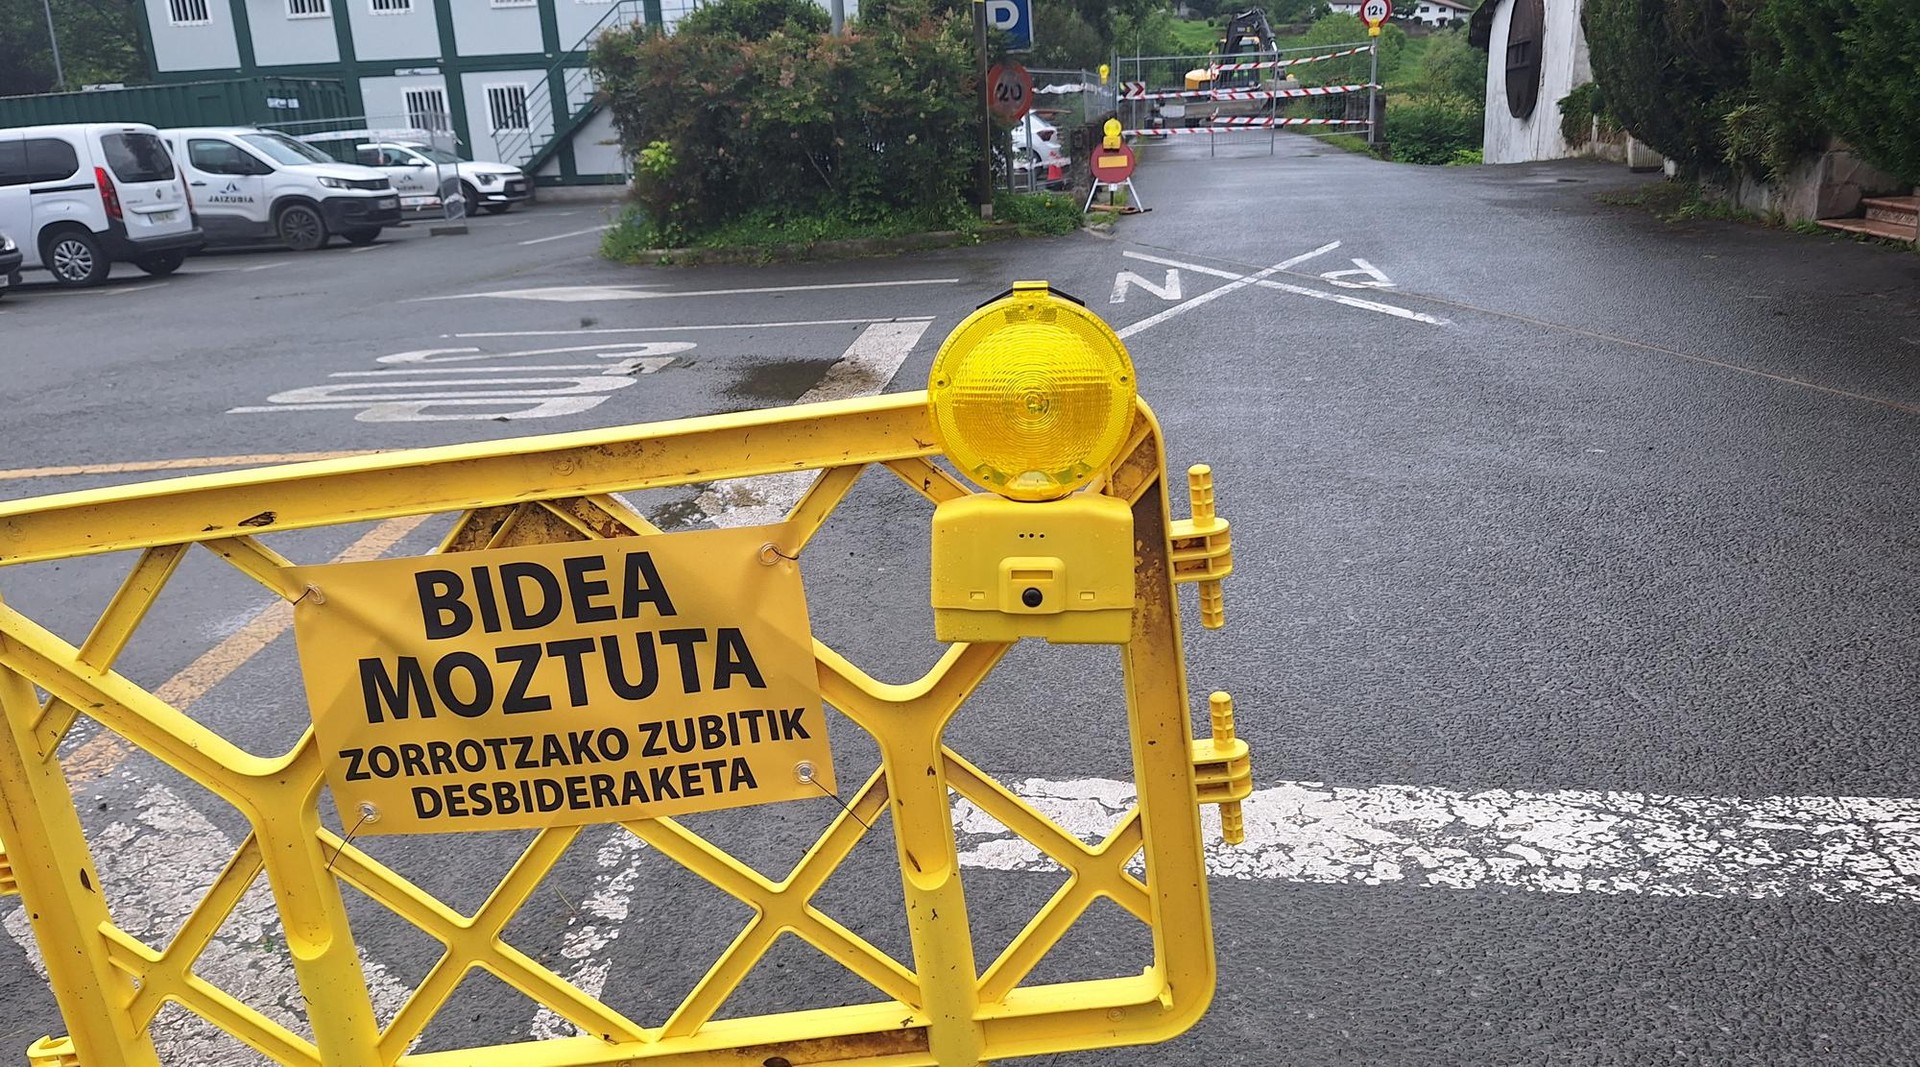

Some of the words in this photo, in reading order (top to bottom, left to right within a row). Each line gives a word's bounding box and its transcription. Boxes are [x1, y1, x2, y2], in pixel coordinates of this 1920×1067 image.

[995, 83, 1022, 103] 20
[208, 195, 254, 203] JAIZUBIA
[413, 551, 677, 641] BIDEA
[358, 627, 767, 724] MOZTUTA
[339, 727, 629, 782] ZORROTZAKO
[639, 707, 811, 758] ZUBITIK
[412, 756, 758, 820] DESBIDERAKETA
